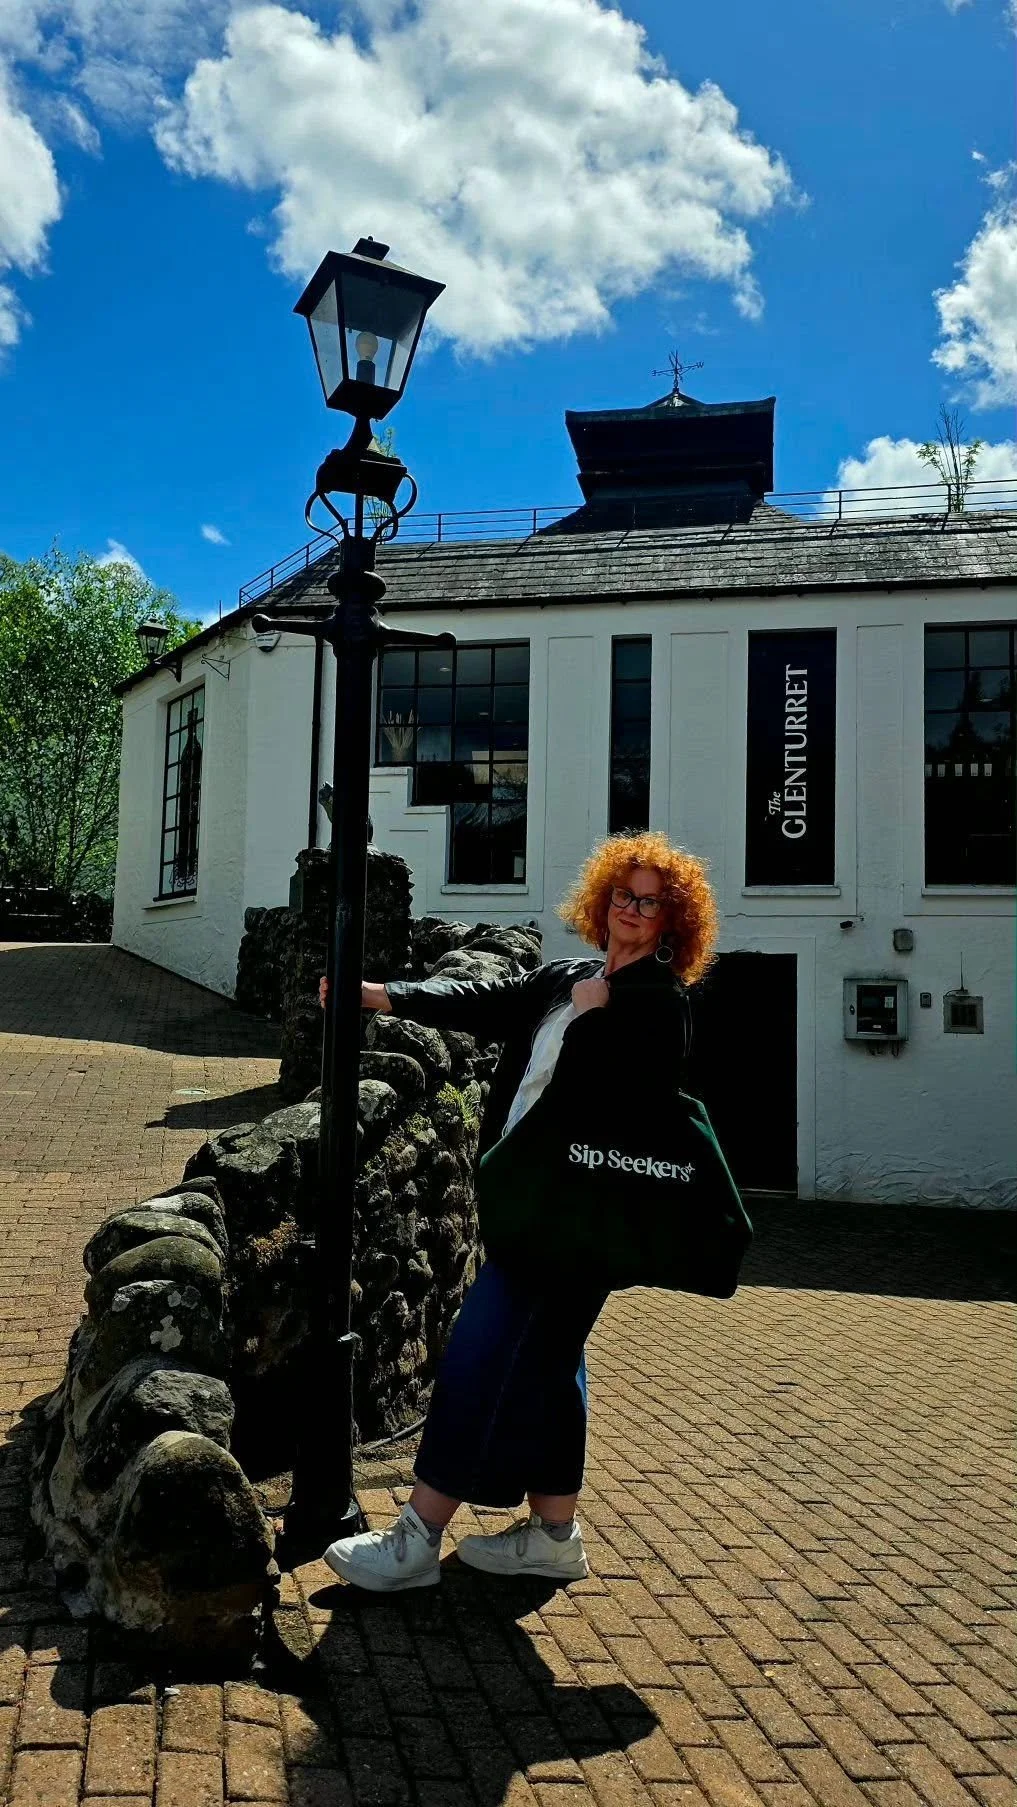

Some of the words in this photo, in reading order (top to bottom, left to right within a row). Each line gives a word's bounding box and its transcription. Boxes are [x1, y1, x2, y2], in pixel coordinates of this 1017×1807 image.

[781, 663, 808, 839] GLENTURRET
[768, 791, 781, 815] The
[568, 1143, 604, 1169] Sip
[607, 1149, 690, 1182] Seekers
